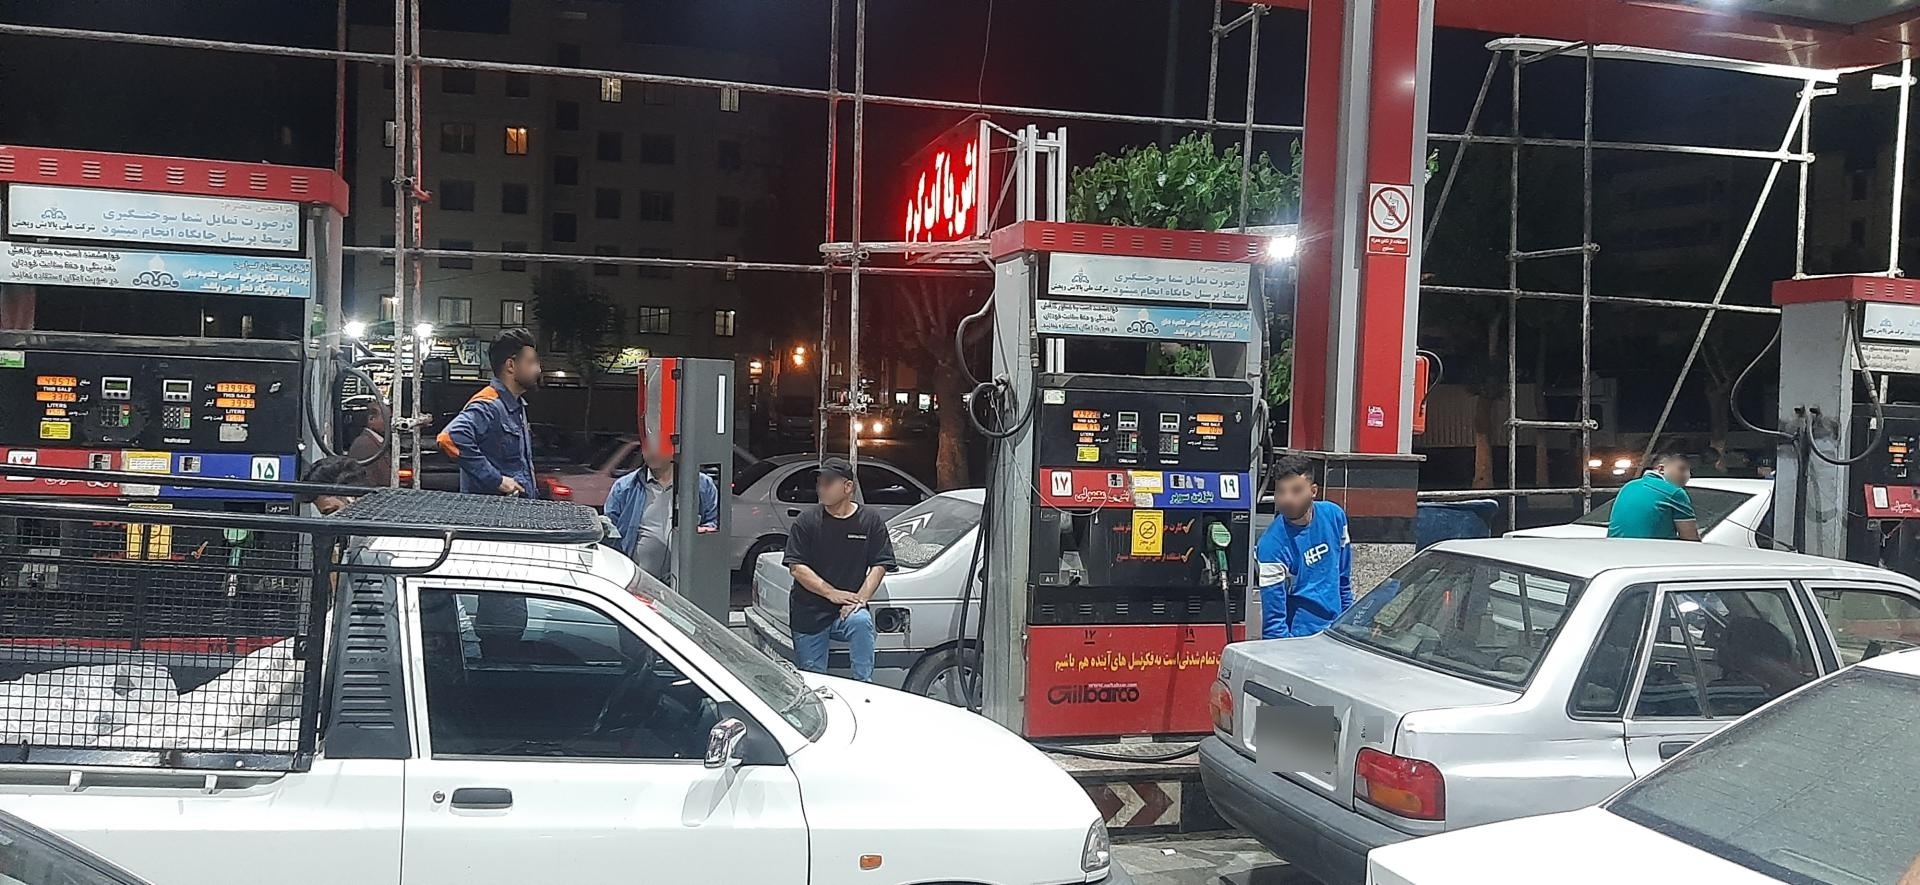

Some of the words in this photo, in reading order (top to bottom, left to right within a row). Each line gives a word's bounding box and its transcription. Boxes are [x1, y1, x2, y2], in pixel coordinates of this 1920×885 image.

[182, 212, 202, 222] شما
[206, 214, 237, 226] تمایل
[60, 222, 73, 231] ملی
[75, 223, 95, 232] شرکت
[142, 227, 174, 238] انجام
[178, 229, 217, 240] جایگاه
[220, 232, 257, 245] پرسنل
[262, 234, 293, 247] توسط
[257, 462, 275, 479] ۱۵
[1055, 475, 1069, 491] ۱۷
[1224, 478, 1236, 493] ۱۹
[1169, 492, 1190, 505] سوپر
[1191, 490, 1215, 504] بنزین
[268, 504, 290, 513] سوپر
[1084, 629, 1096, 639] ۱۷
[1055, 652, 1075, 672] باشیم
[1078, 656, 1089, 672] هم
[1090, 650, 1112, 671] آینده
[1110, 652, 1127, 672] های
[1154, 654, 1162, 669] به
[1163, 651, 1179, 666] است
[1178, 651, 1200, 670] شدنی
[1200, 650, 1216, 669] تمام
